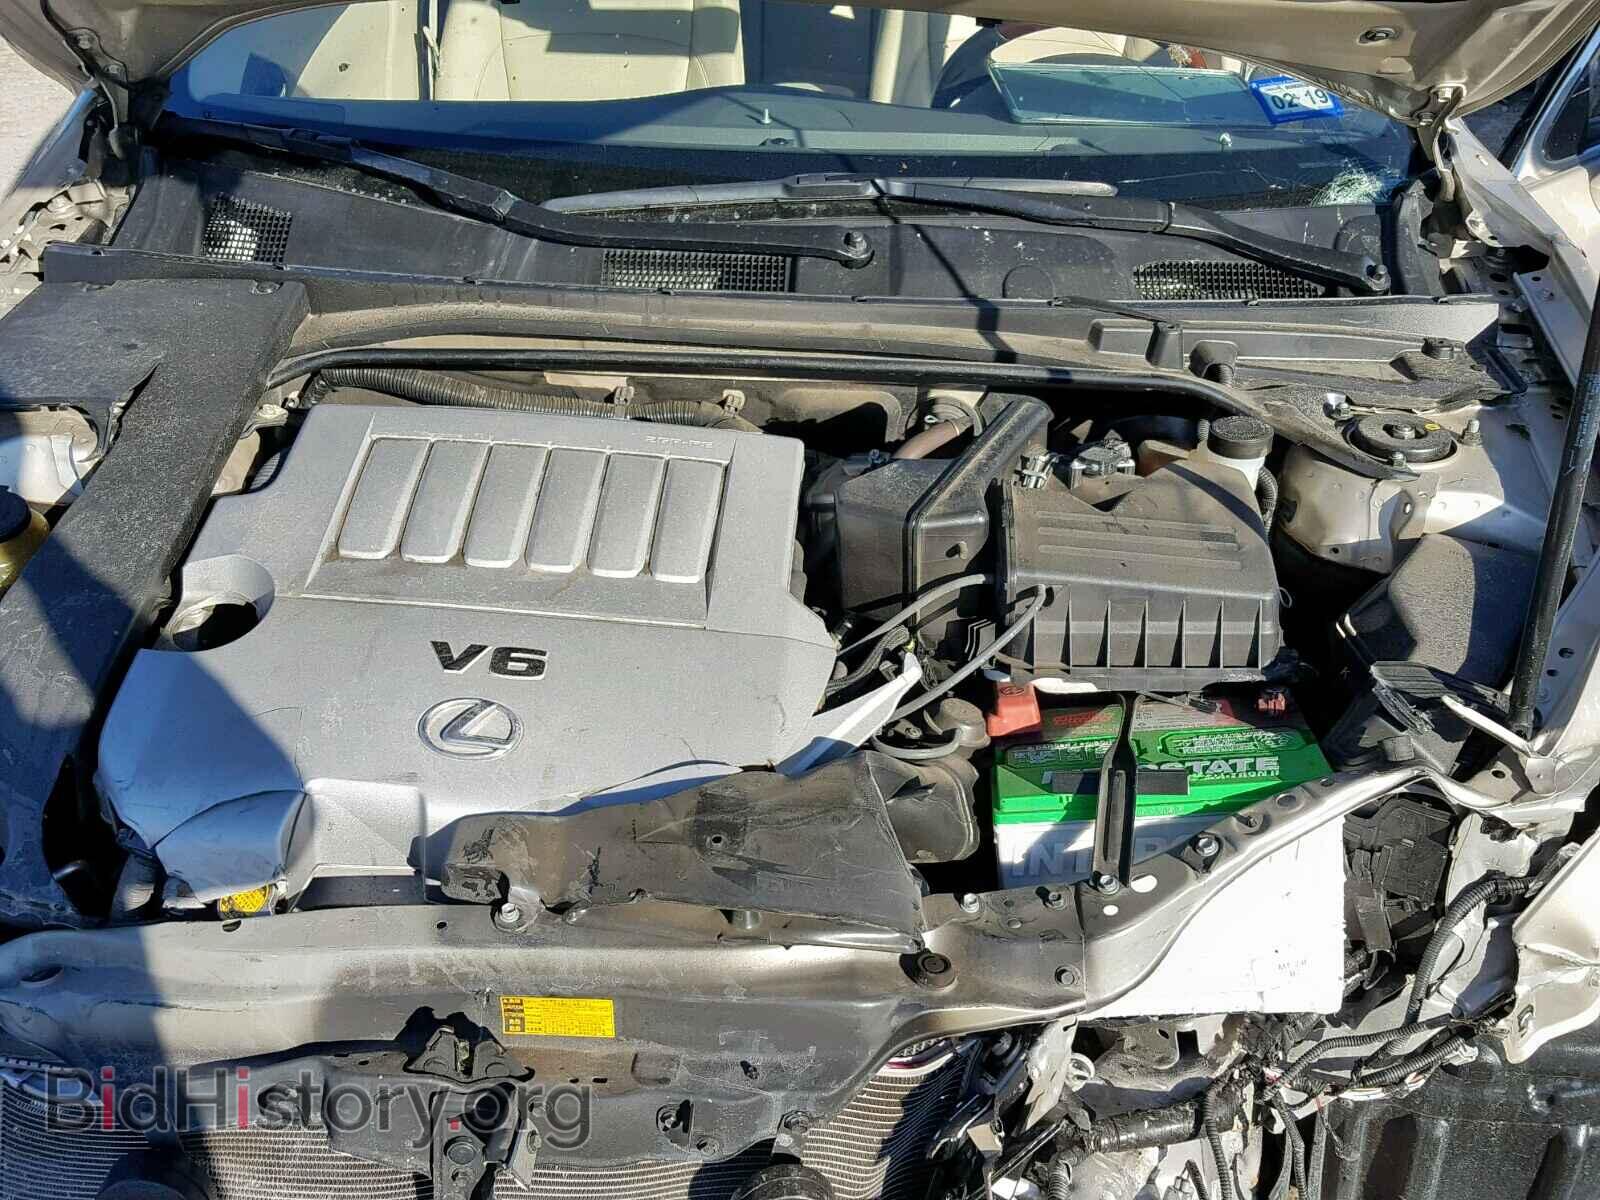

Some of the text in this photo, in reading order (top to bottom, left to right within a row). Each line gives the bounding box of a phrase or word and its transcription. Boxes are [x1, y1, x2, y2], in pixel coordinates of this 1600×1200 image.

[1271, 89, 1328, 109] 02 19
[430, 640, 547, 678] V6
